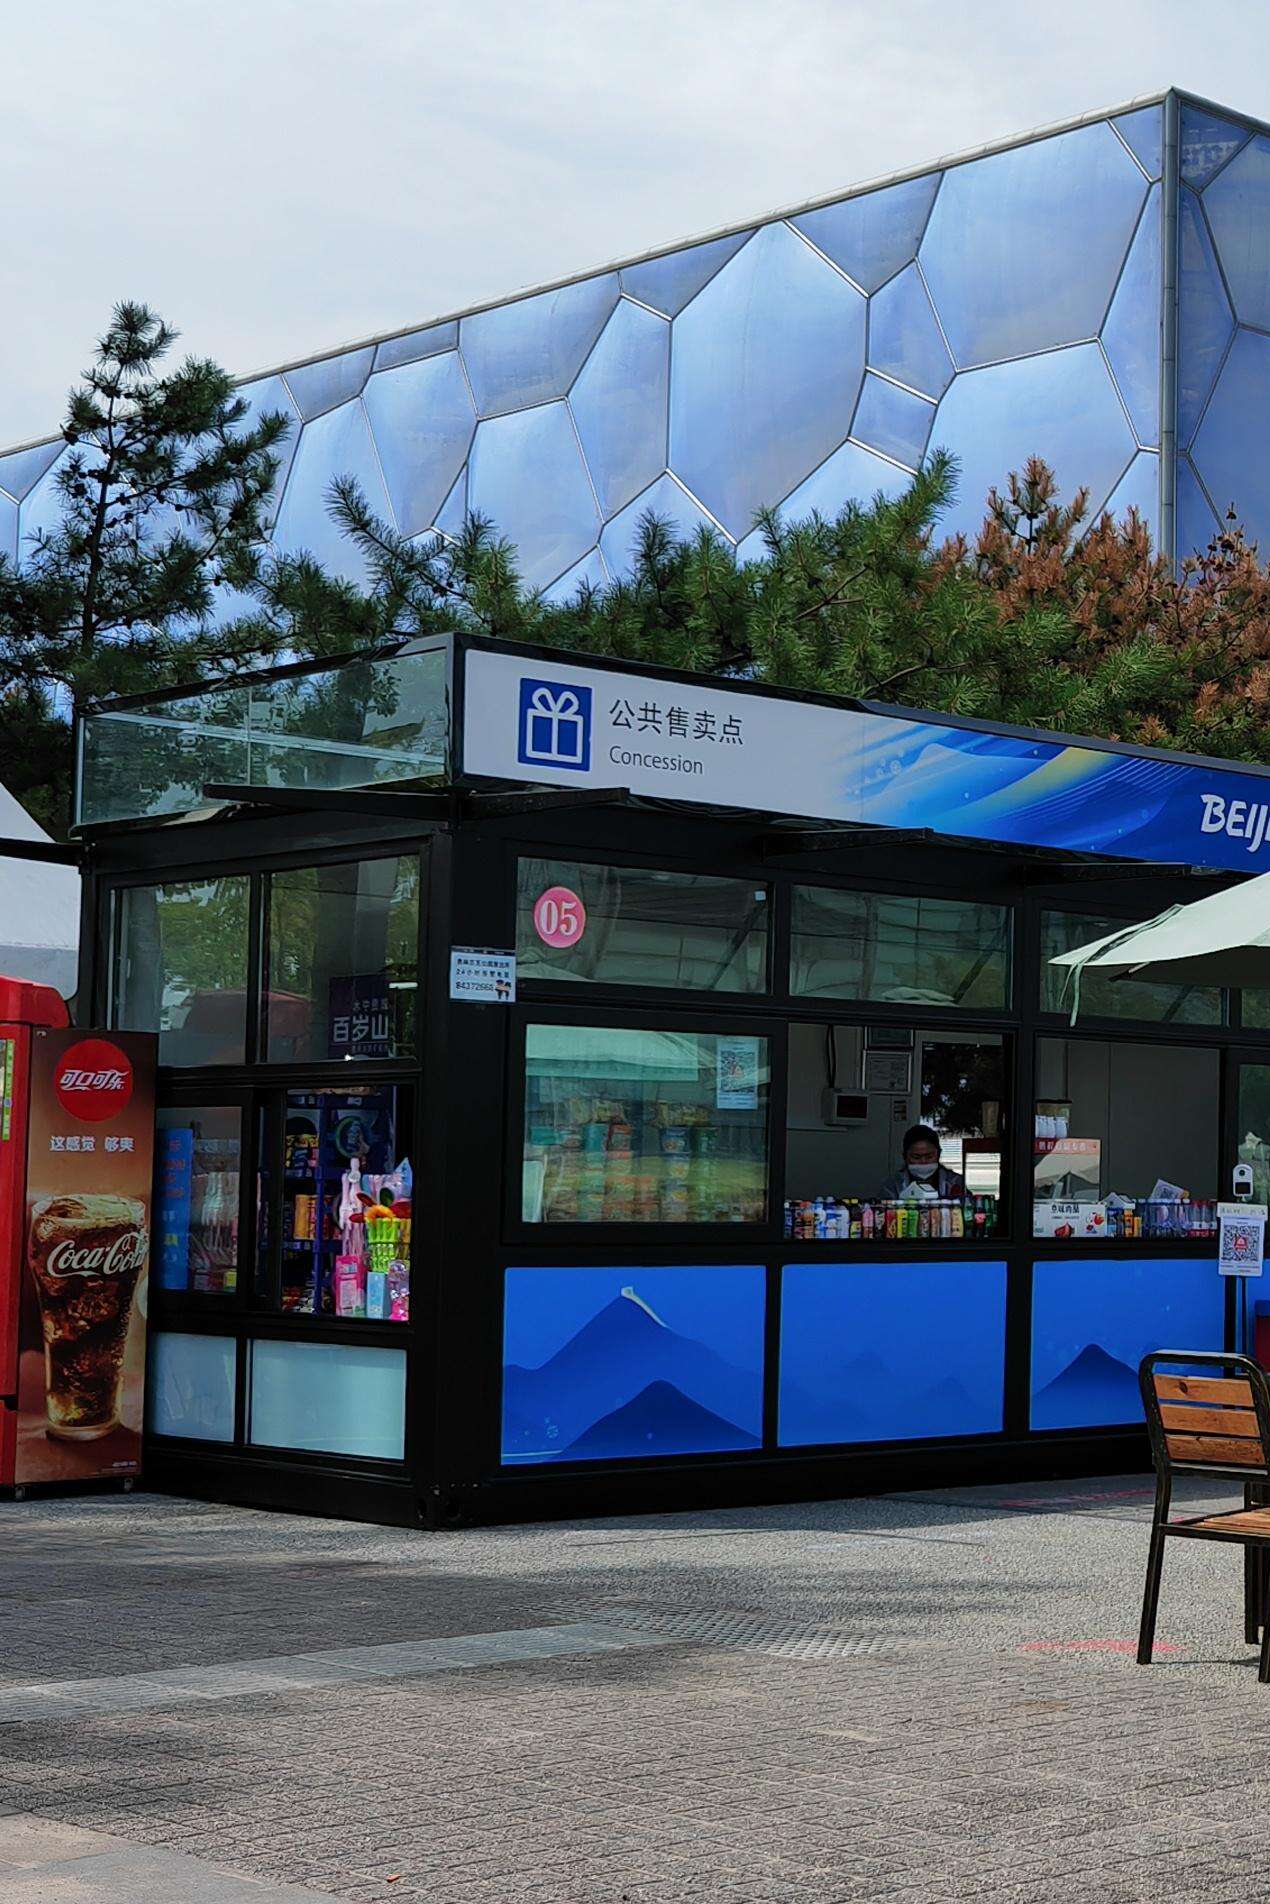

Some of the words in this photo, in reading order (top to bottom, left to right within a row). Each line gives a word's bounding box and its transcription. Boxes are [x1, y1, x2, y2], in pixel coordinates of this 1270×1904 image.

[609, 699, 743, 745] 公共售卖点
[609, 746, 703, 774] Concession
[540, 899, 578, 936] 05
[333, 1013, 389, 1043] 百岁山
[60, 1069, 129, 1091] 可口可乐
[50, 1136, 96, 1152] 这感觉
[46, 1231, 149, 1278] Coca-Cola
